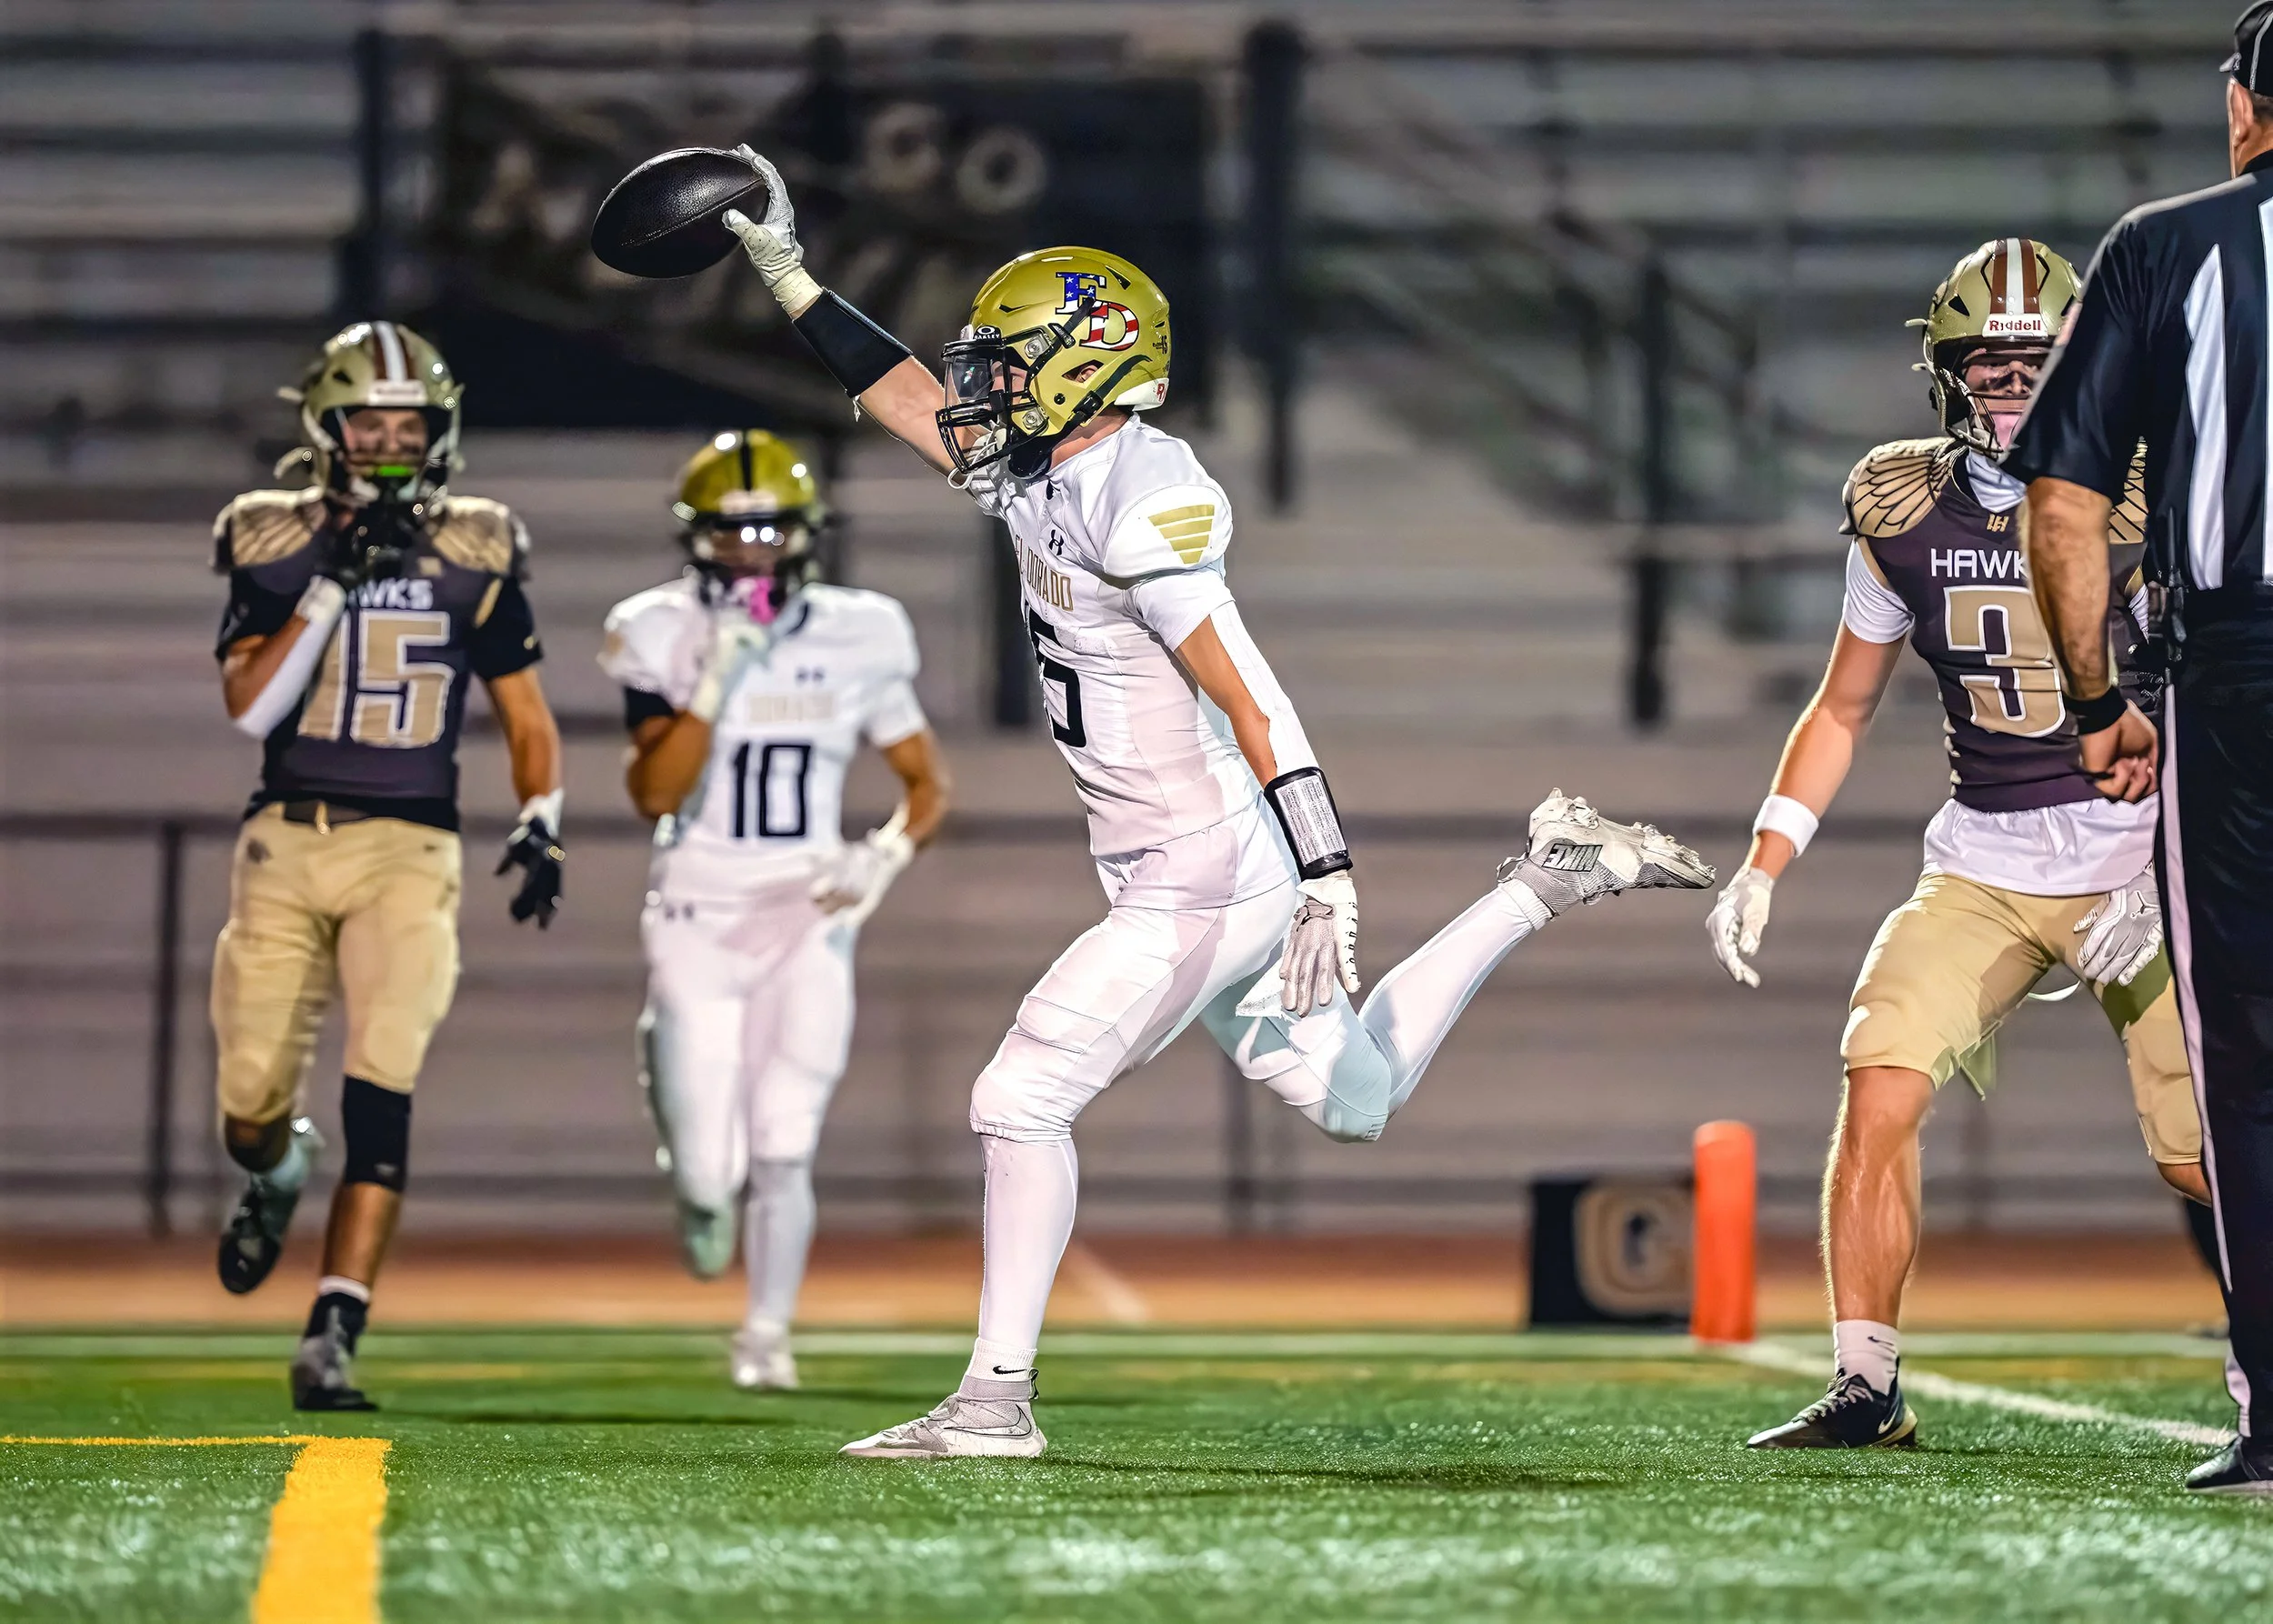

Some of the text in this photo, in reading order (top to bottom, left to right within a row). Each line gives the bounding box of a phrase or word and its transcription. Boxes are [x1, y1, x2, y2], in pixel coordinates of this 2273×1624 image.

[1989, 320, 2041, 331] Riddell
[348, 577, 434, 610] WKS
[1027, 546, 1074, 611] DORADO
[1930, 547, 2028, 579] HAWK
[298, 610, 455, 748] 15
[1944, 586, 2066, 738] 3
[734, 742, 811, 837] 10
